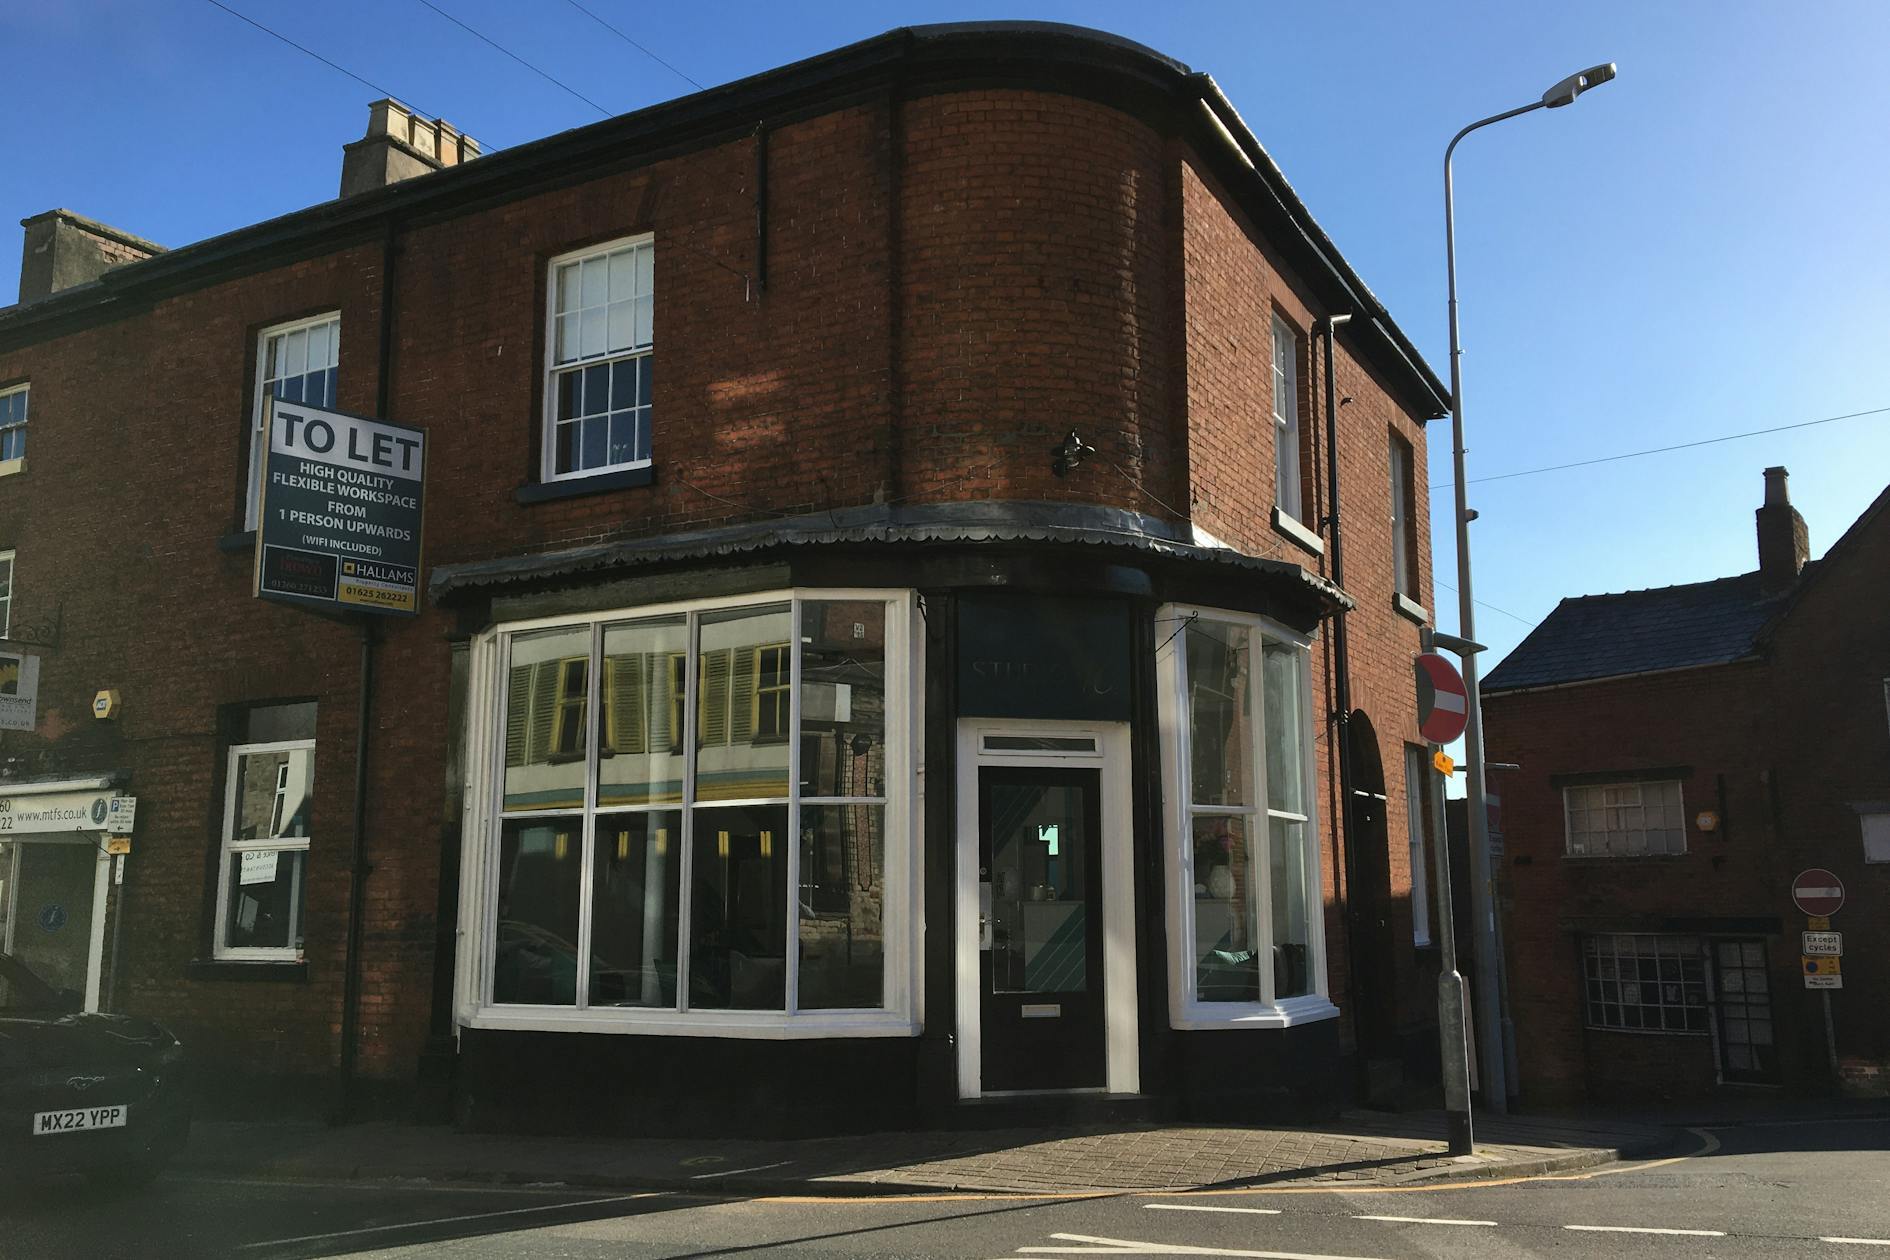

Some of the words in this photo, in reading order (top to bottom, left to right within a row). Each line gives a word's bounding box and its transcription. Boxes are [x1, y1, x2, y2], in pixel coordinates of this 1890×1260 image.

[277, 411, 336, 454] TO
[348, 427, 420, 471] LET
[300, 461, 334, 479] HIGH
[337, 469, 394, 491] QUALITY
[273, 471, 335, 495] FLEXIBLE
[337, 484, 417, 510] WORKSPACE
[327, 501, 366, 518] FROM
[279, 508, 286, 520] 1
[290, 510, 343, 530] PERSON
[347, 520, 411, 541] UPWARDS
[302, 535, 328, 548] (WIFI
[330, 539, 383, 556] INCLUDED)
[356, 564, 414, 584] HALLAMS
[346, 586, 374, 598] 01625
[375, 591, 408, 602] 262222
[0, 817, 13, 829] 22
[17, 807, 87, 821] www.mtfs.co.uk
[1807, 936, 1837, 944] Except
[1808, 944, 1837, 952] cycles
[41, 1112, 85, 1131] MX22
[90, 1108, 120, 1126] YPP
